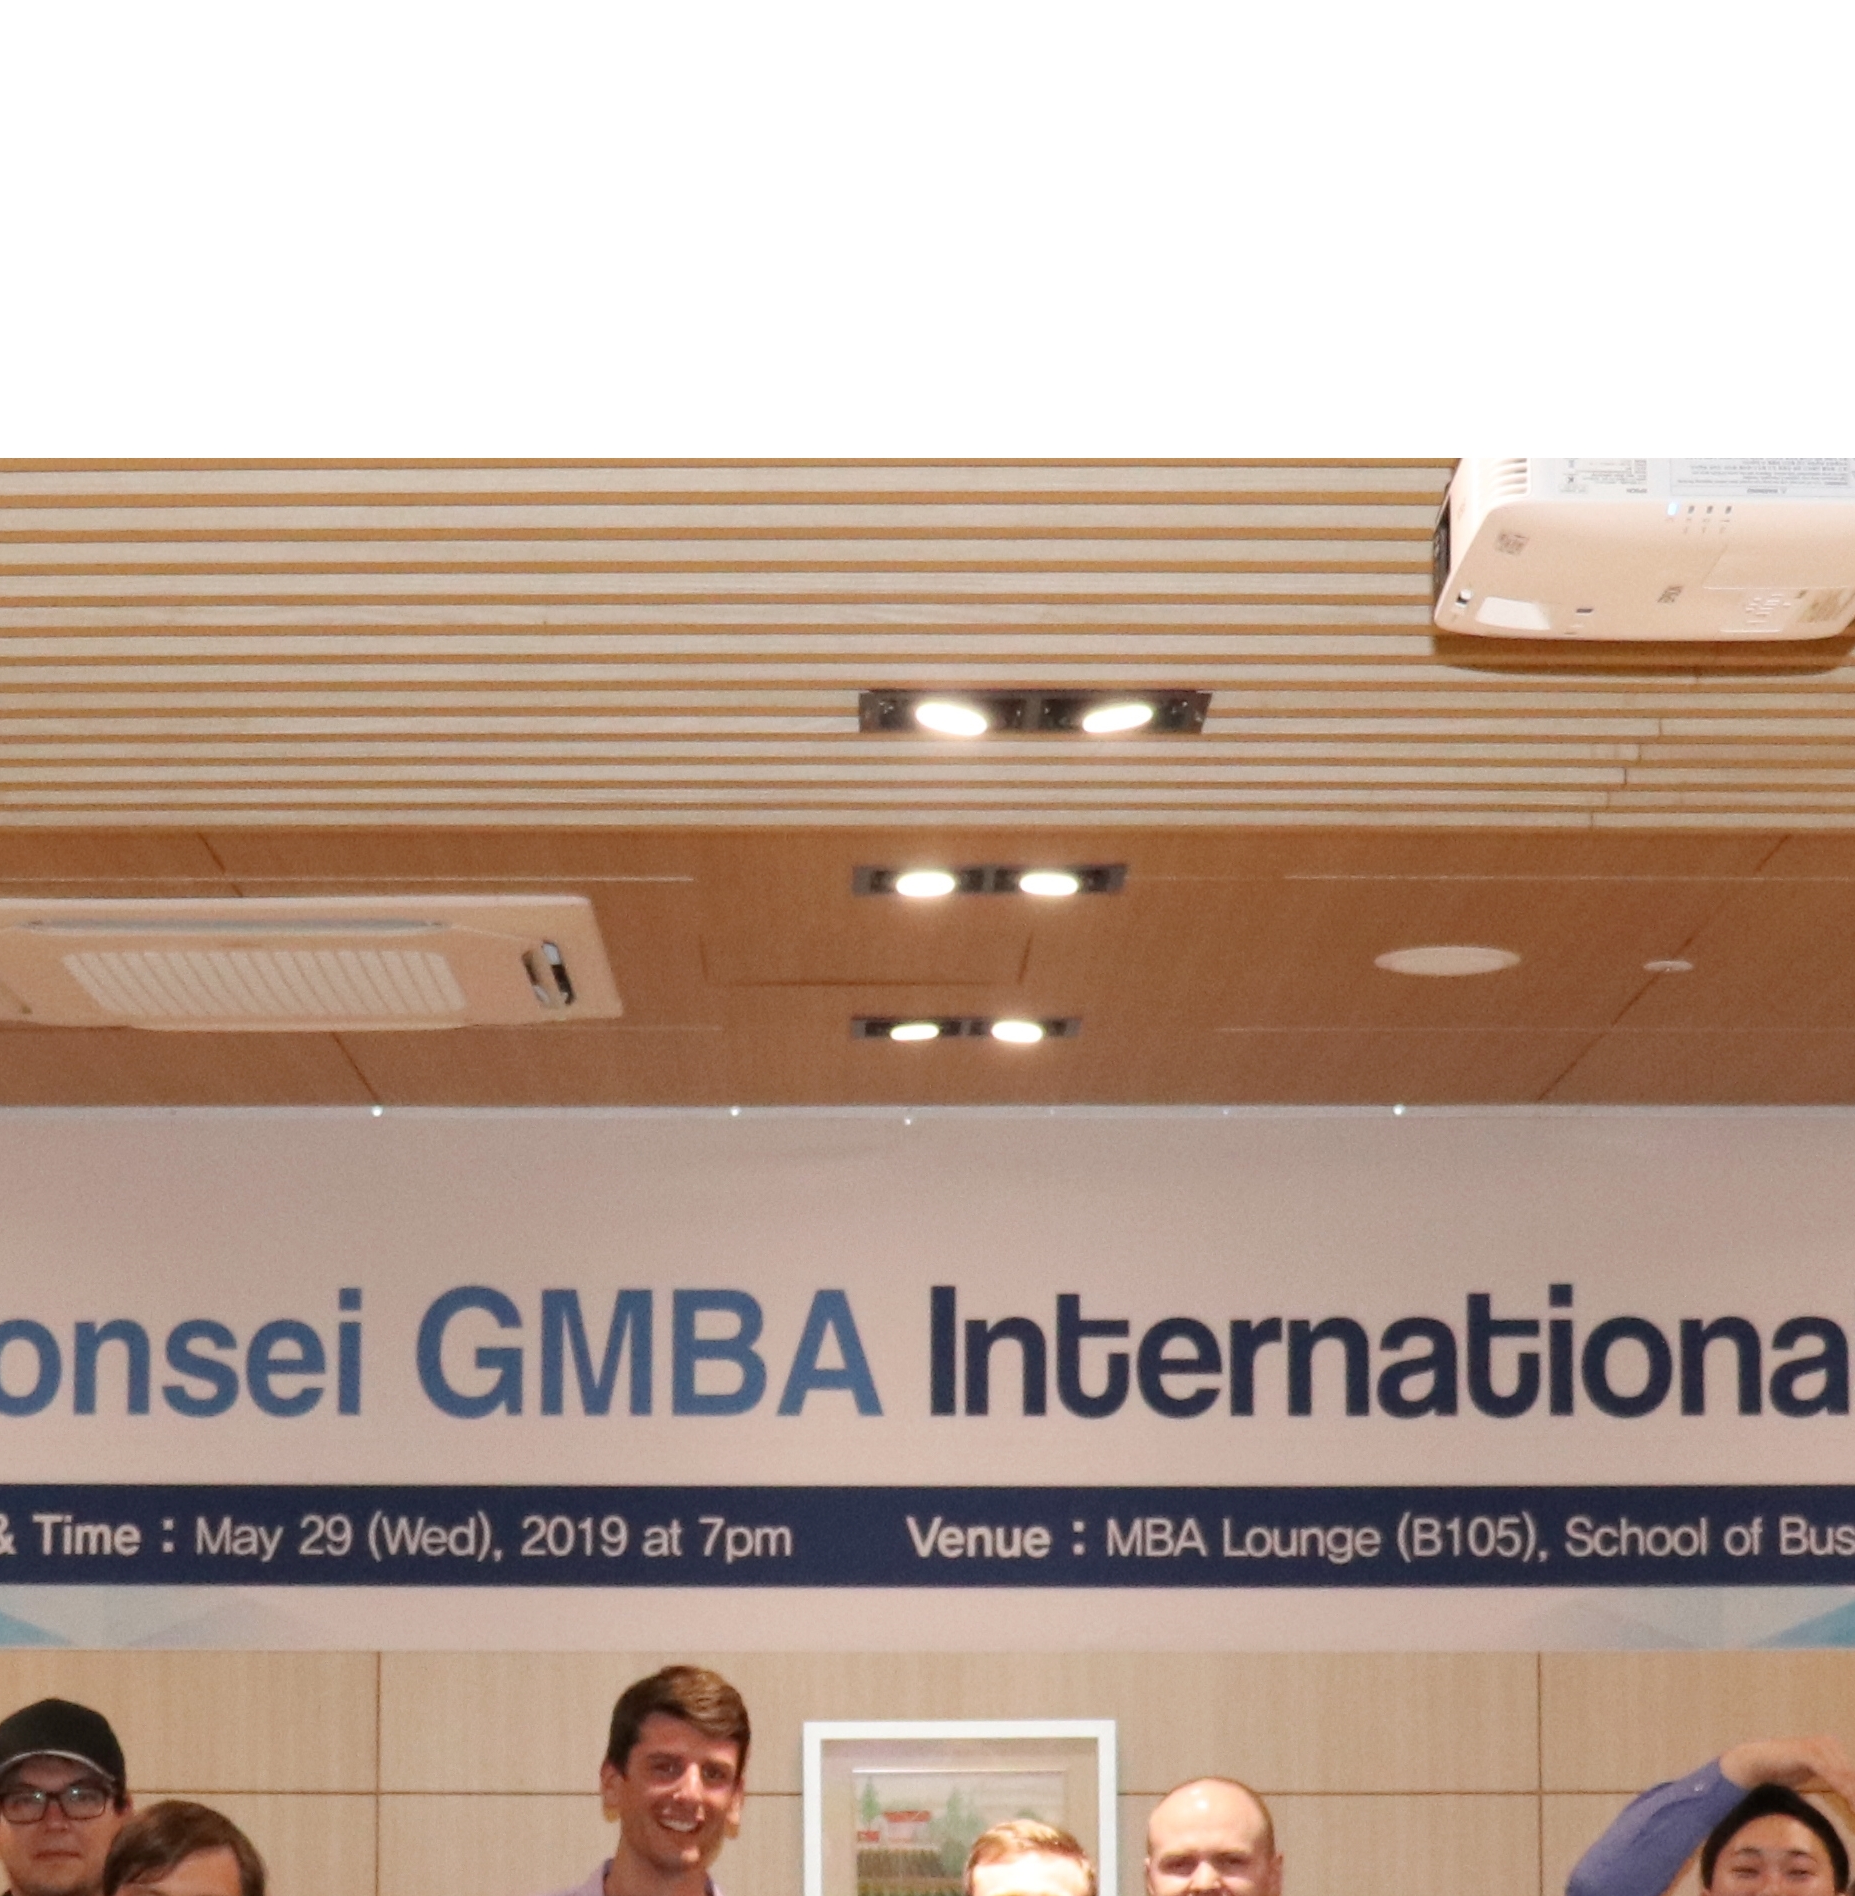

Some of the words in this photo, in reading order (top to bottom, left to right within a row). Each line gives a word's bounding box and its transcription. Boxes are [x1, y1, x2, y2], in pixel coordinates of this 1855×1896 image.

[415, 1284, 883, 1420] GMBA
[32, 1513, 142, 1556] Time
[196, 1516, 284, 1563] May
[299, 1514, 353, 1556] 29
[367, 1511, 503, 1563] (Wed),
[520, 1515, 629, 1558] 2019
[641, 1518, 683, 1558] at
[698, 1516, 793, 1564] 7pm
[905, 1515, 1053, 1559] Venue
[1106, 1516, 1208, 1558] MBA
[1222, 1516, 1382, 1565] Lounge
[1396, 1511, 1548, 1564] (B105),
[1565, 1515, 1709, 1558] School
[1723, 1516, 1764, 1557] of
